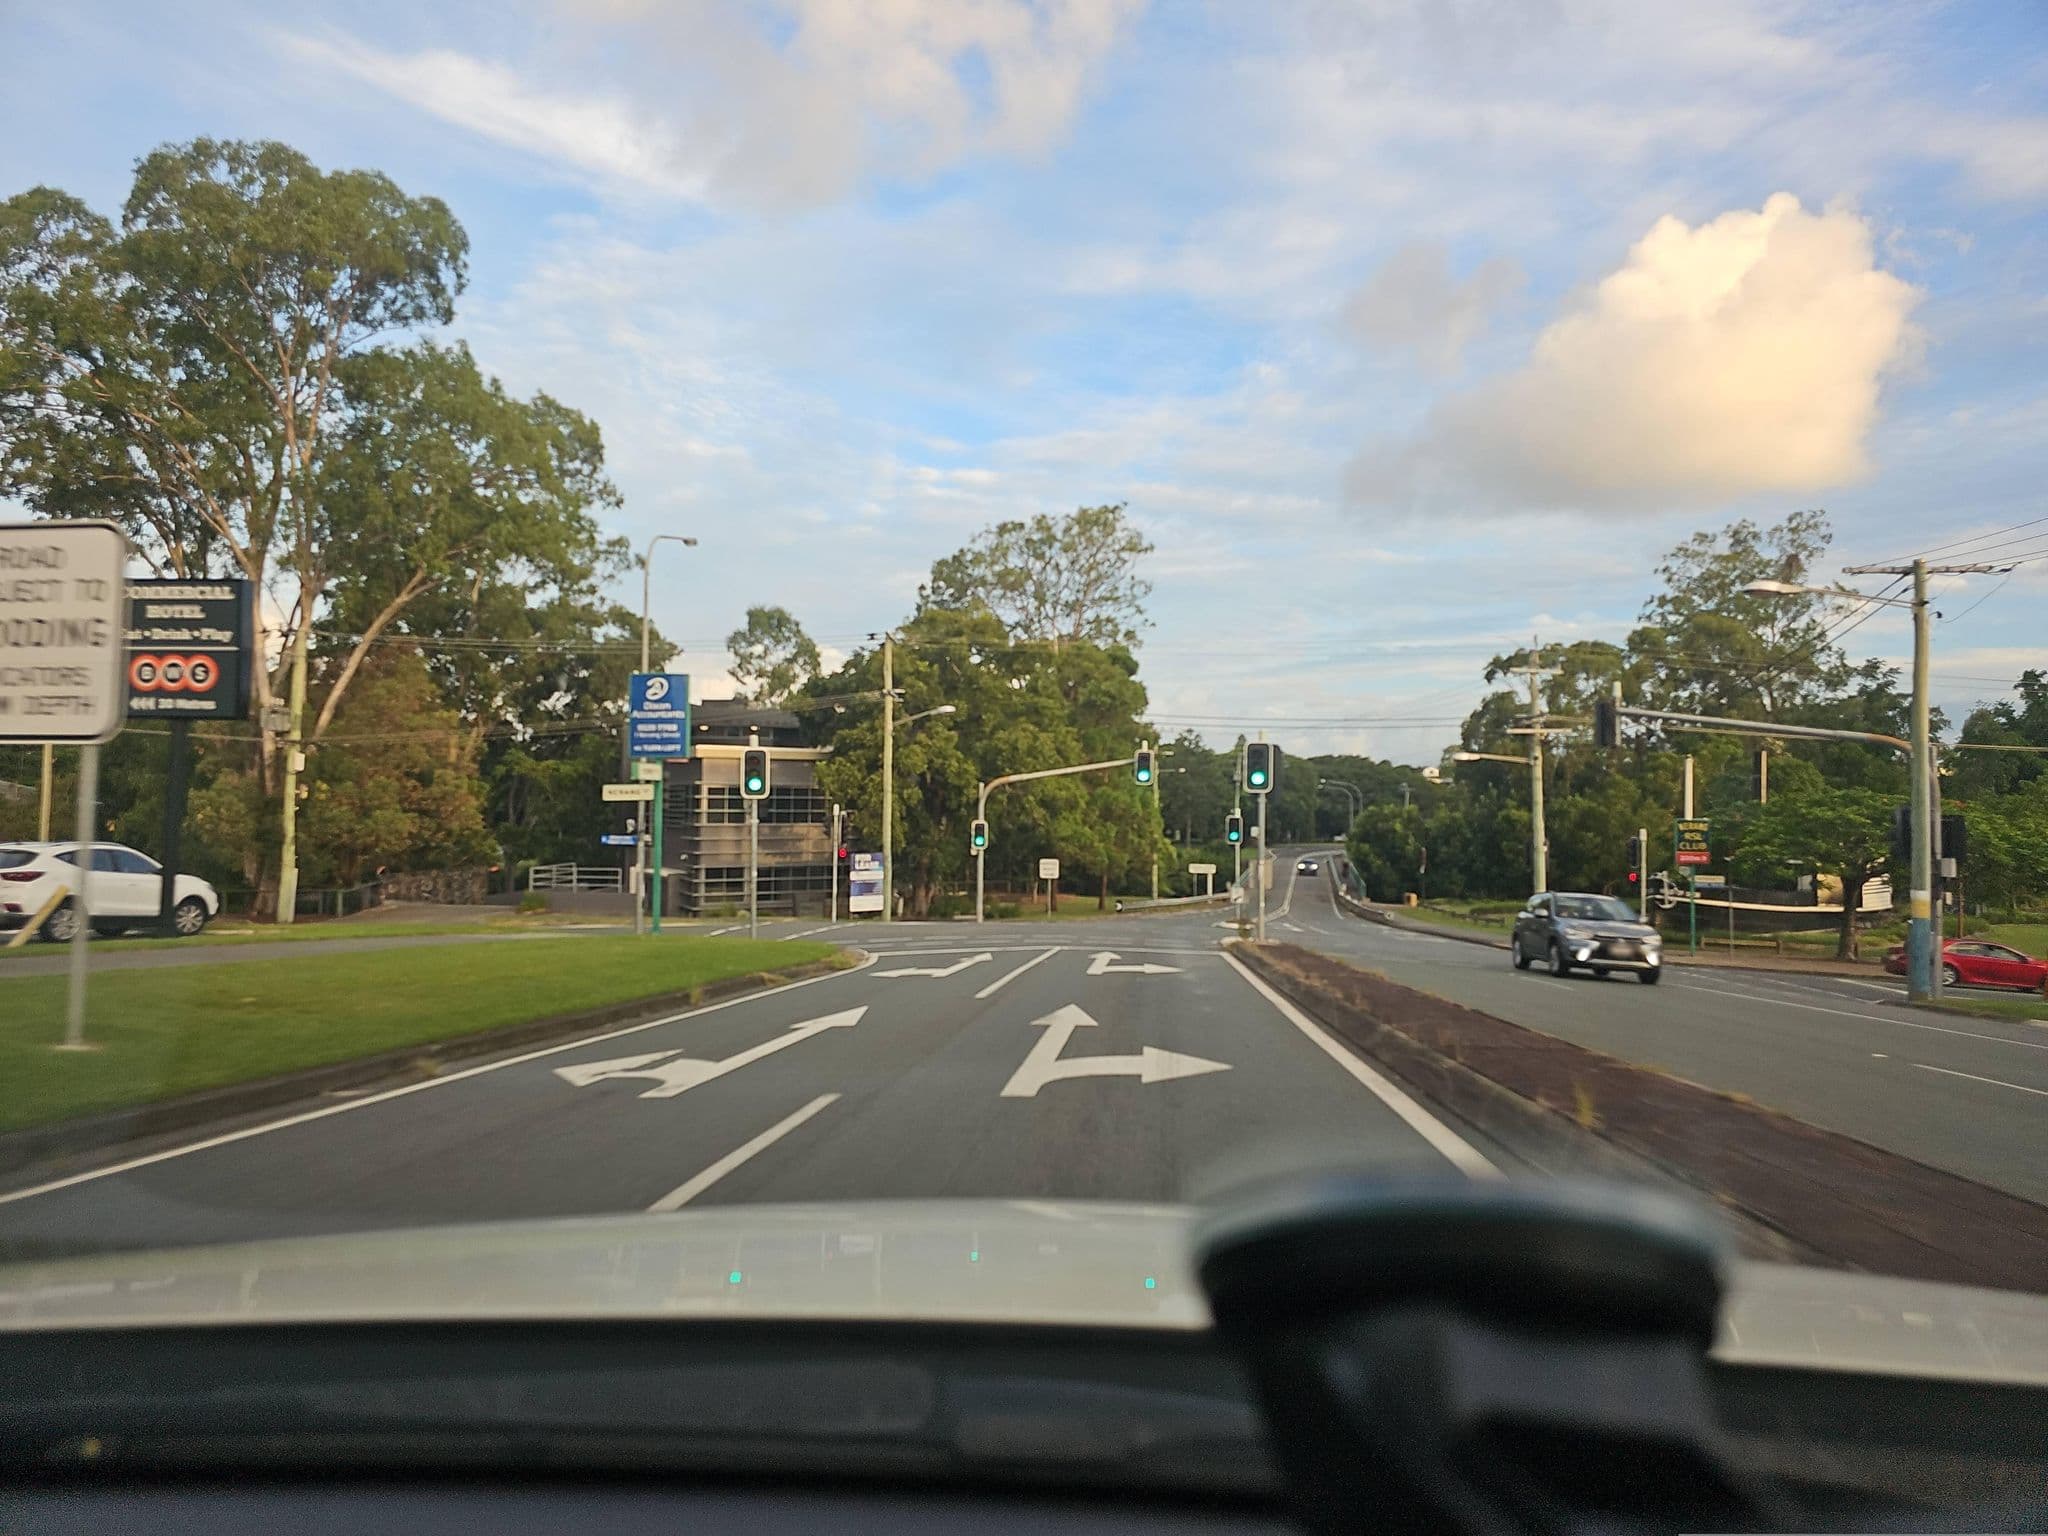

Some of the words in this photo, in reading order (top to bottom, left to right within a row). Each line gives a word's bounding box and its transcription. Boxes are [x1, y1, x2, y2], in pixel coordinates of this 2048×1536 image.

[76, 579, 107, 602] TO
[145, 605, 207, 619] HOTEL
[1679, 842, 1708, 850] CLUB
